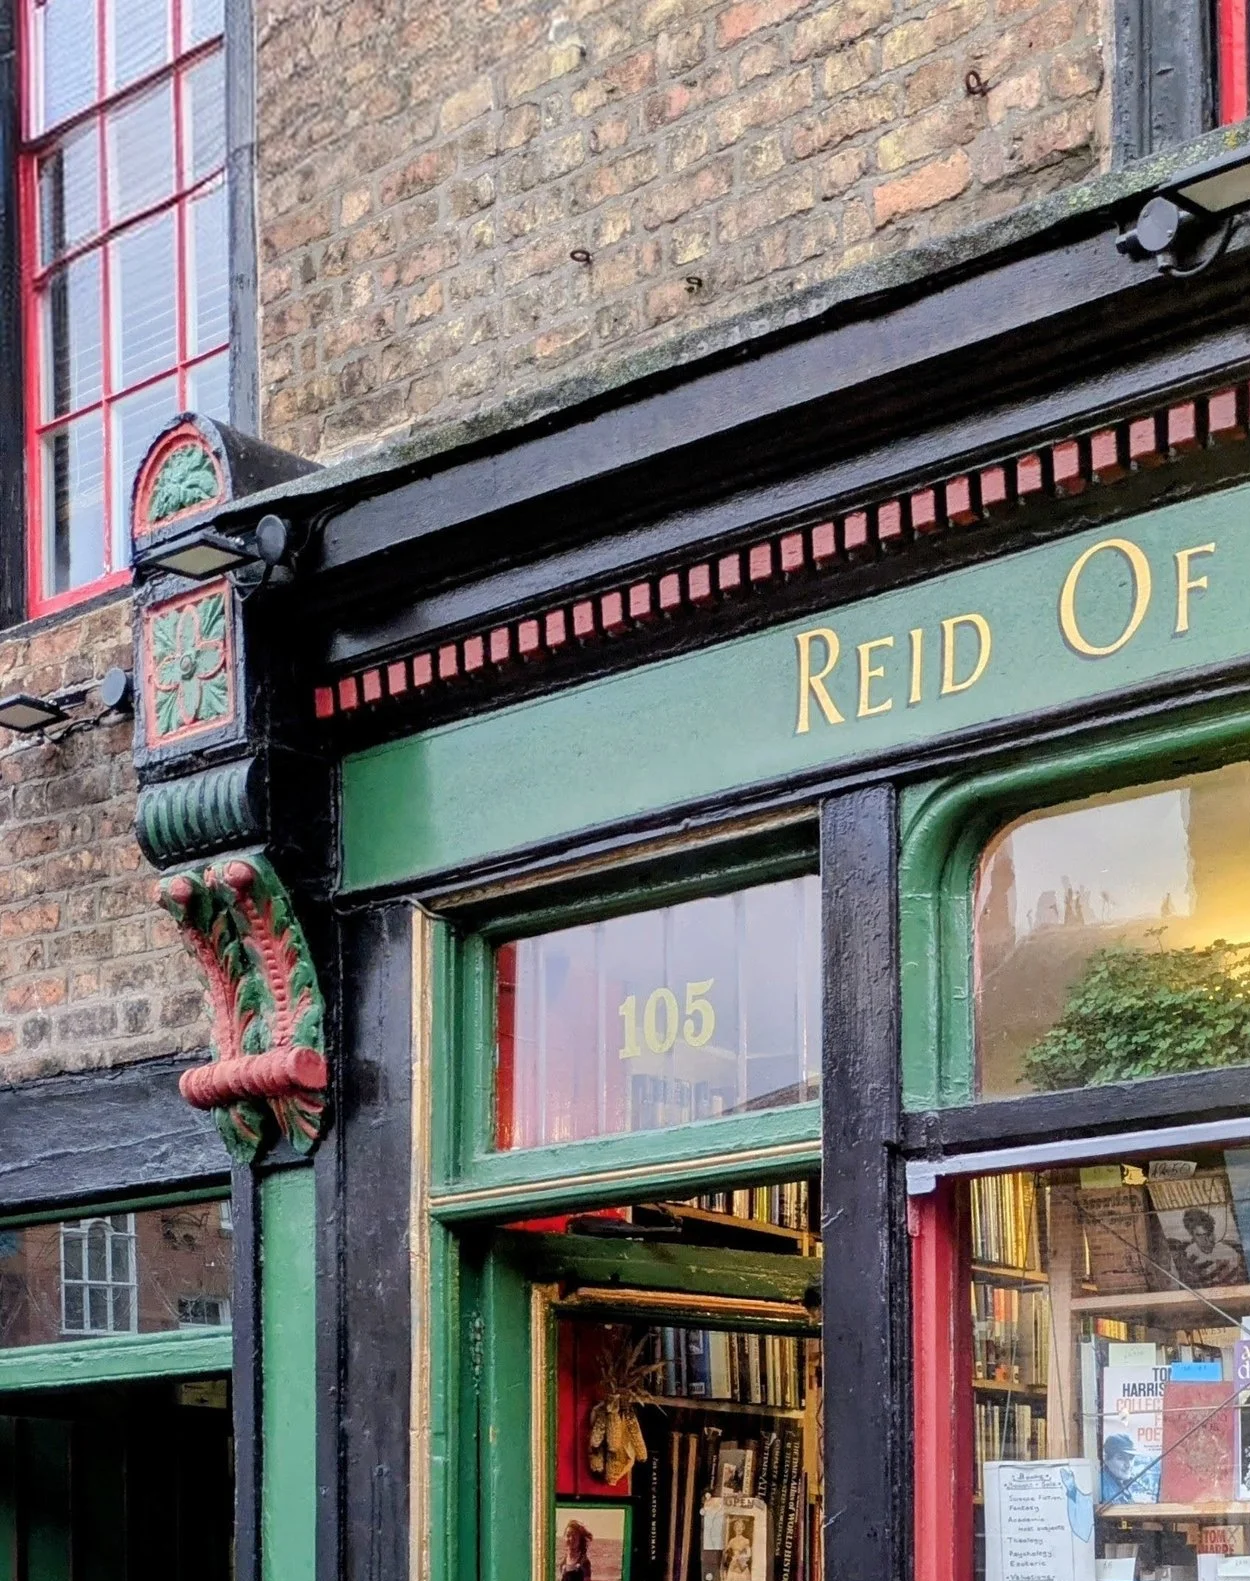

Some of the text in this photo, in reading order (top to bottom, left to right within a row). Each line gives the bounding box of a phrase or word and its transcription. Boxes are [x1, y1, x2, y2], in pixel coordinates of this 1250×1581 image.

[794, 612, 993, 735] REID
[1059, 536, 1215, 658] OF
[618, 977, 715, 1059] 105
[1007, 1537, 1043, 1545] Theology
